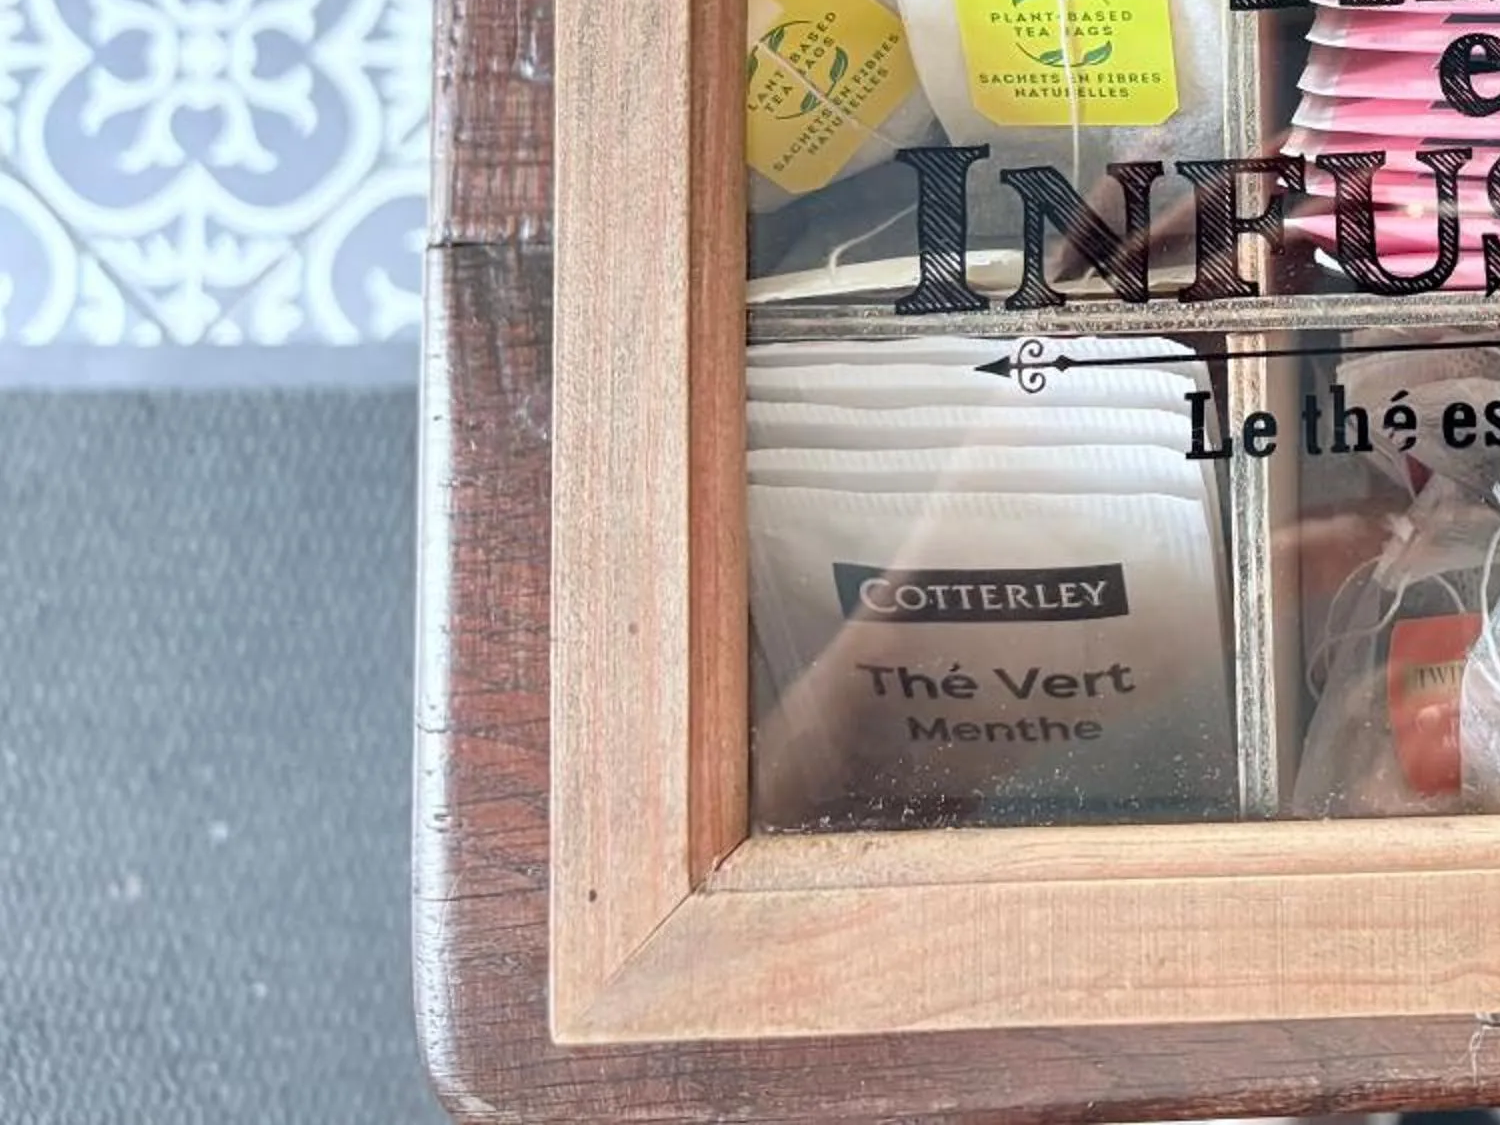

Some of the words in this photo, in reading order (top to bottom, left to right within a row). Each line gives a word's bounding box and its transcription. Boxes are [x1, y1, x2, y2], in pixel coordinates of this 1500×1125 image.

[1014, 26, 1050, 37] TEA
[979, 73, 1061, 84] SACHETS
[1097, 72, 1162, 84] FIBRES
[764, 84, 793, 113] TEA
[772, 108, 833, 172] SACHETS
[831, 86, 851, 106] EN
[853, 33, 900, 84] FIBRES
[1184, 390, 1278, 460] Le
[1301, 384, 1418, 455] thé
[858, 578, 1109, 613] COTTERLEY
[855, 662, 979, 699] Thé
[993, 661, 1137, 700] Vert
[905, 714, 1104, 743] Menthe
